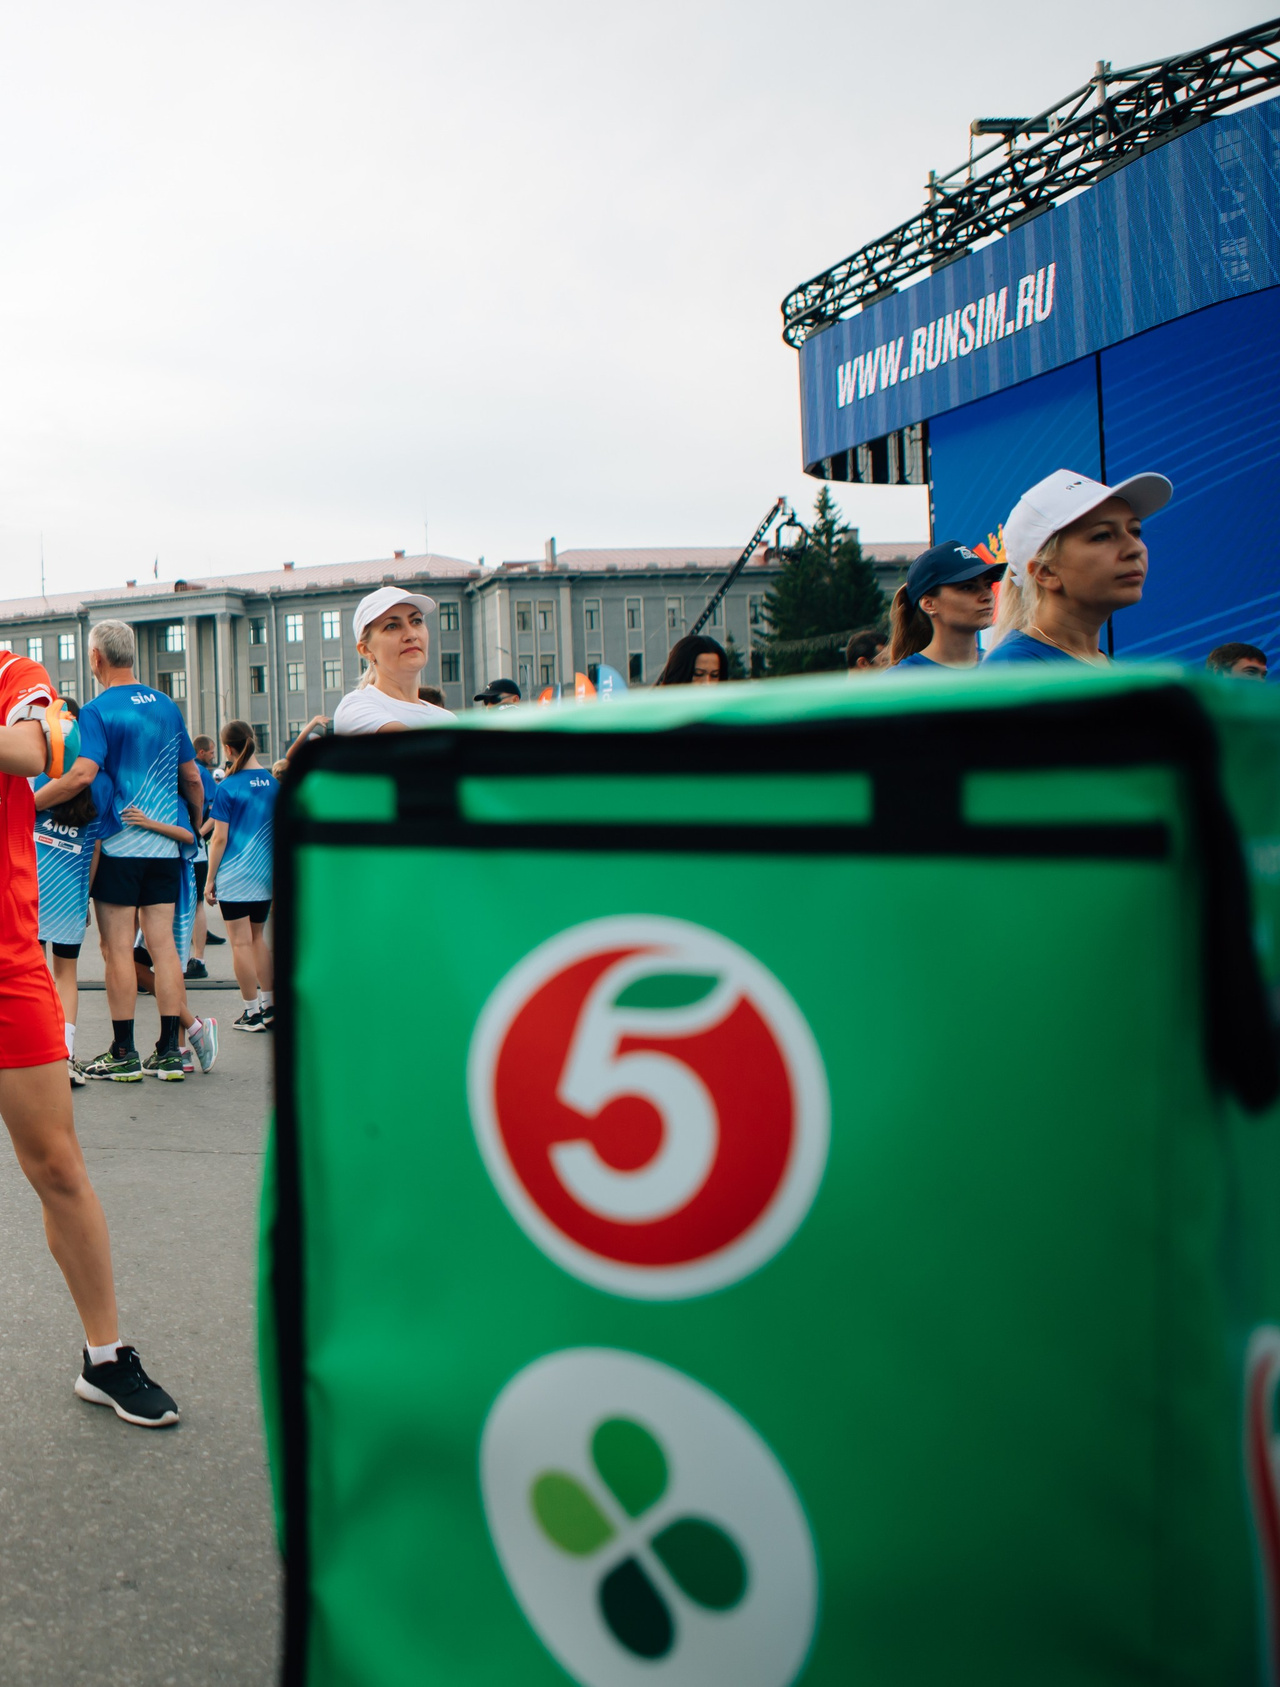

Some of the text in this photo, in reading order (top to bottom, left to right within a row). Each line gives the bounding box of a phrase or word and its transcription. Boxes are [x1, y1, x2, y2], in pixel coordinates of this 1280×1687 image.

[836, 262, 1056, 408] WWW.RUNSIM.RU
[42, 818, 79, 838] 4106
[548, 950, 738, 1224] 5
